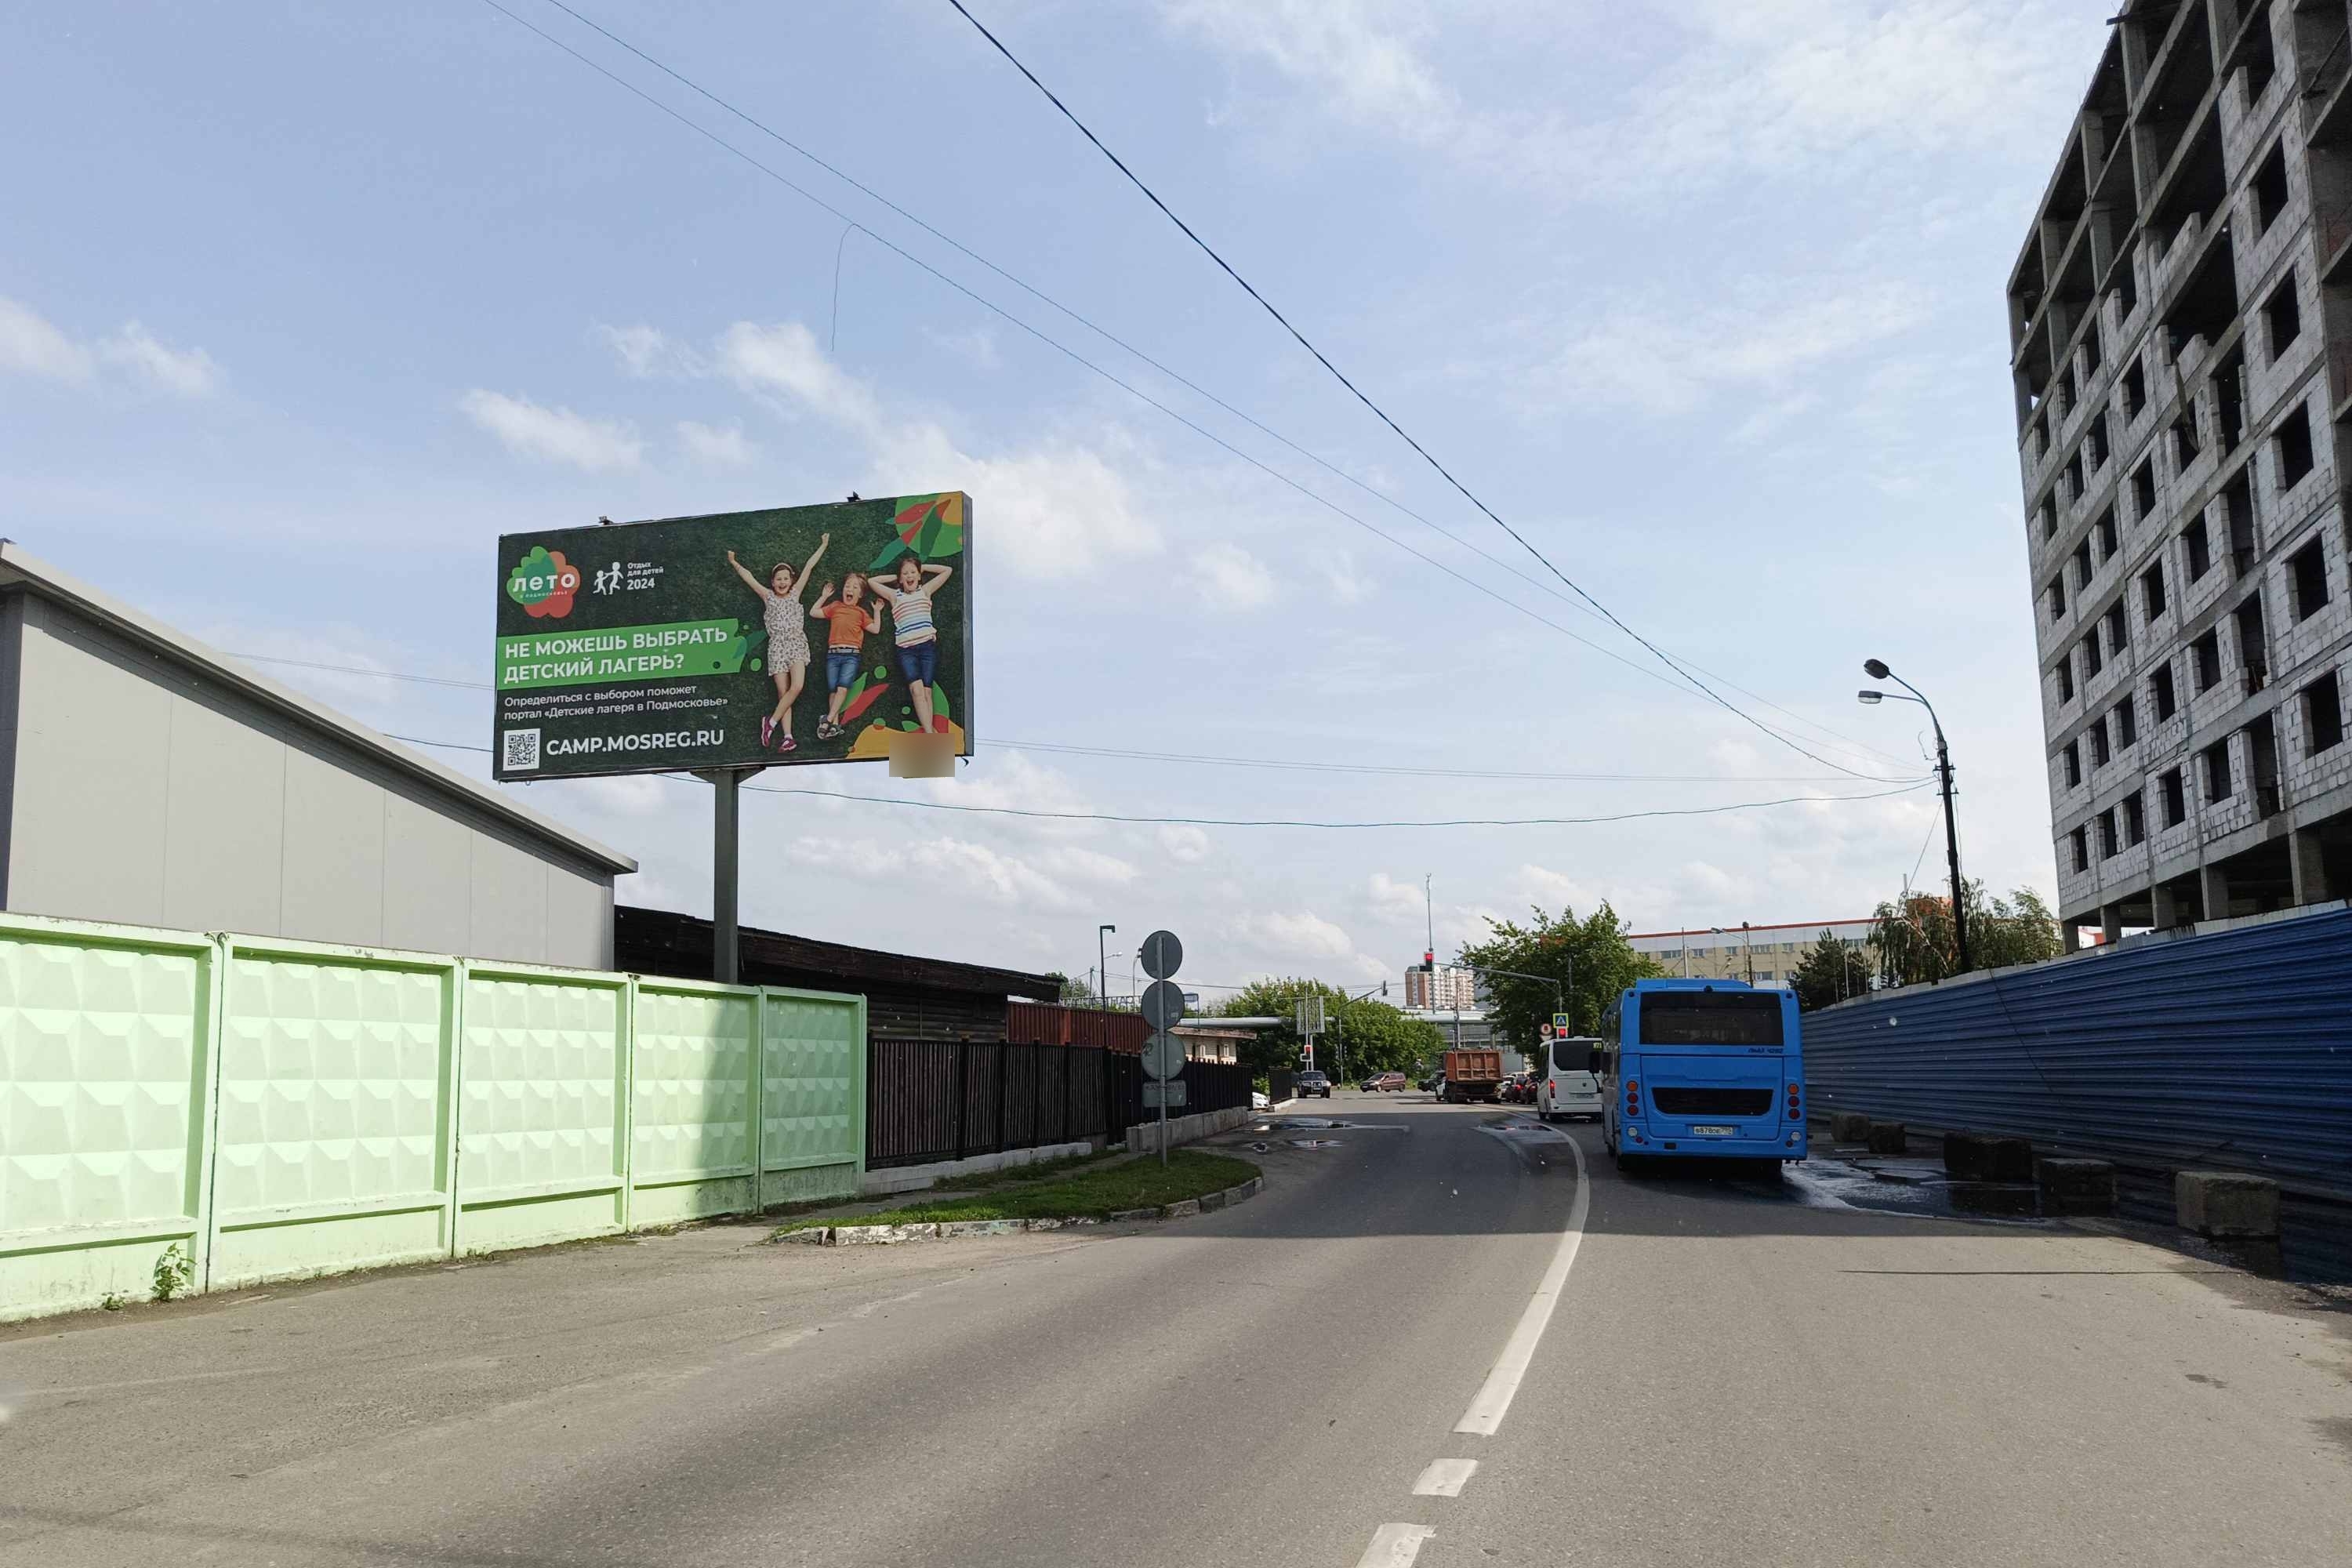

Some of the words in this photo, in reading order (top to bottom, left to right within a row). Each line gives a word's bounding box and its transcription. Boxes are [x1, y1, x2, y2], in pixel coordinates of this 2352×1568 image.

[627, 561, 652, 570] Отдых
[642, 567, 664, 576] детей
[627, 578, 655, 590] 2024
[505, 642, 530, 659] НЕ
[535, 635, 627, 656] МОЖЕШЬ
[633, 627, 728, 649] ВЫБРАТЬ
[504, 657, 593, 684] ДЕТСКИЙ
[598, 653, 684, 675] ЛАГЕРЬ?
[504, 692, 583, 707] Определиться
[593, 690, 644, 701] выбором
[647, 685, 697, 697] поможет
[504, 710, 542, 721] портал
[544, 706, 594, 719] «Детские
[596, 702, 634, 714] лагеря
[647, 697, 728, 711] Подмосковье»
[546, 729, 724, 755] CAMP.MOSREG.RU
